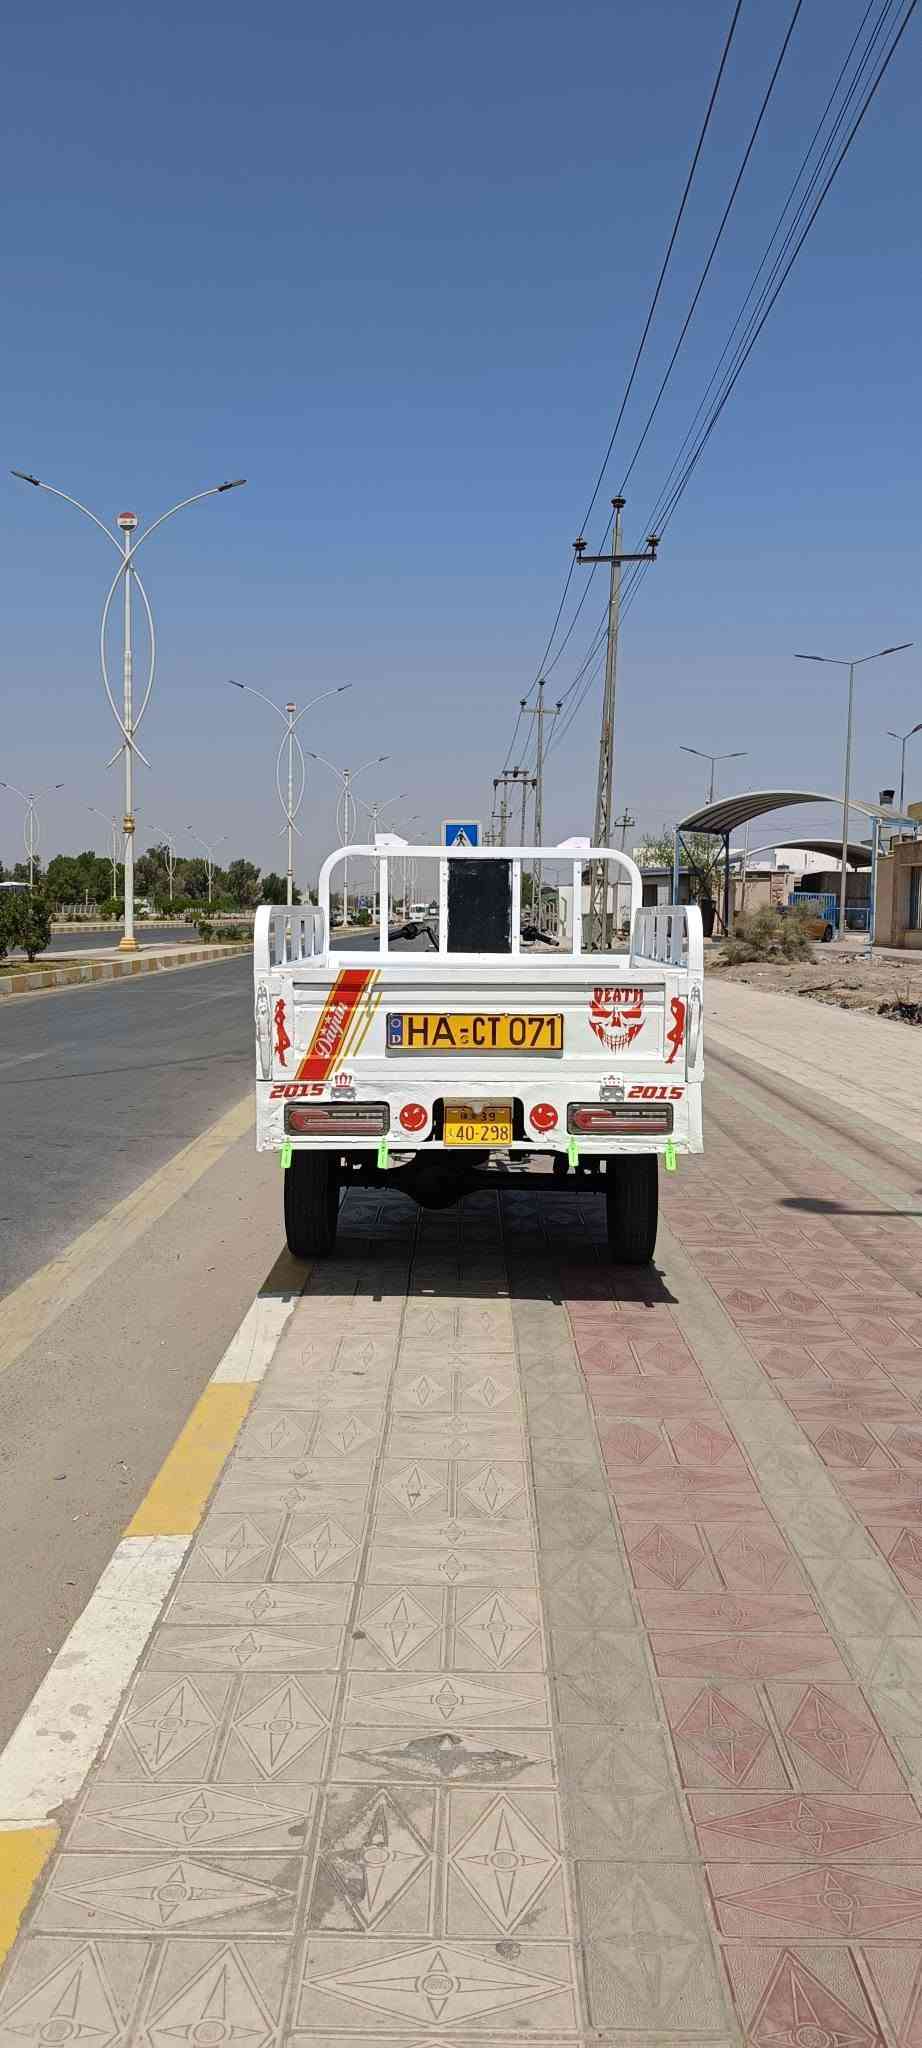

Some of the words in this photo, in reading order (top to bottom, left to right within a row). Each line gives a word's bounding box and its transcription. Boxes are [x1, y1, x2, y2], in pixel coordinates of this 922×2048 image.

[593, 987, 645, 1003] DEATH
[392, 1034, 401, 1043] D
[509, 1017, 556, 1047] 071
[269, 1083, 326, 1099] 2015
[627, 1085, 685, 1100] 2015
